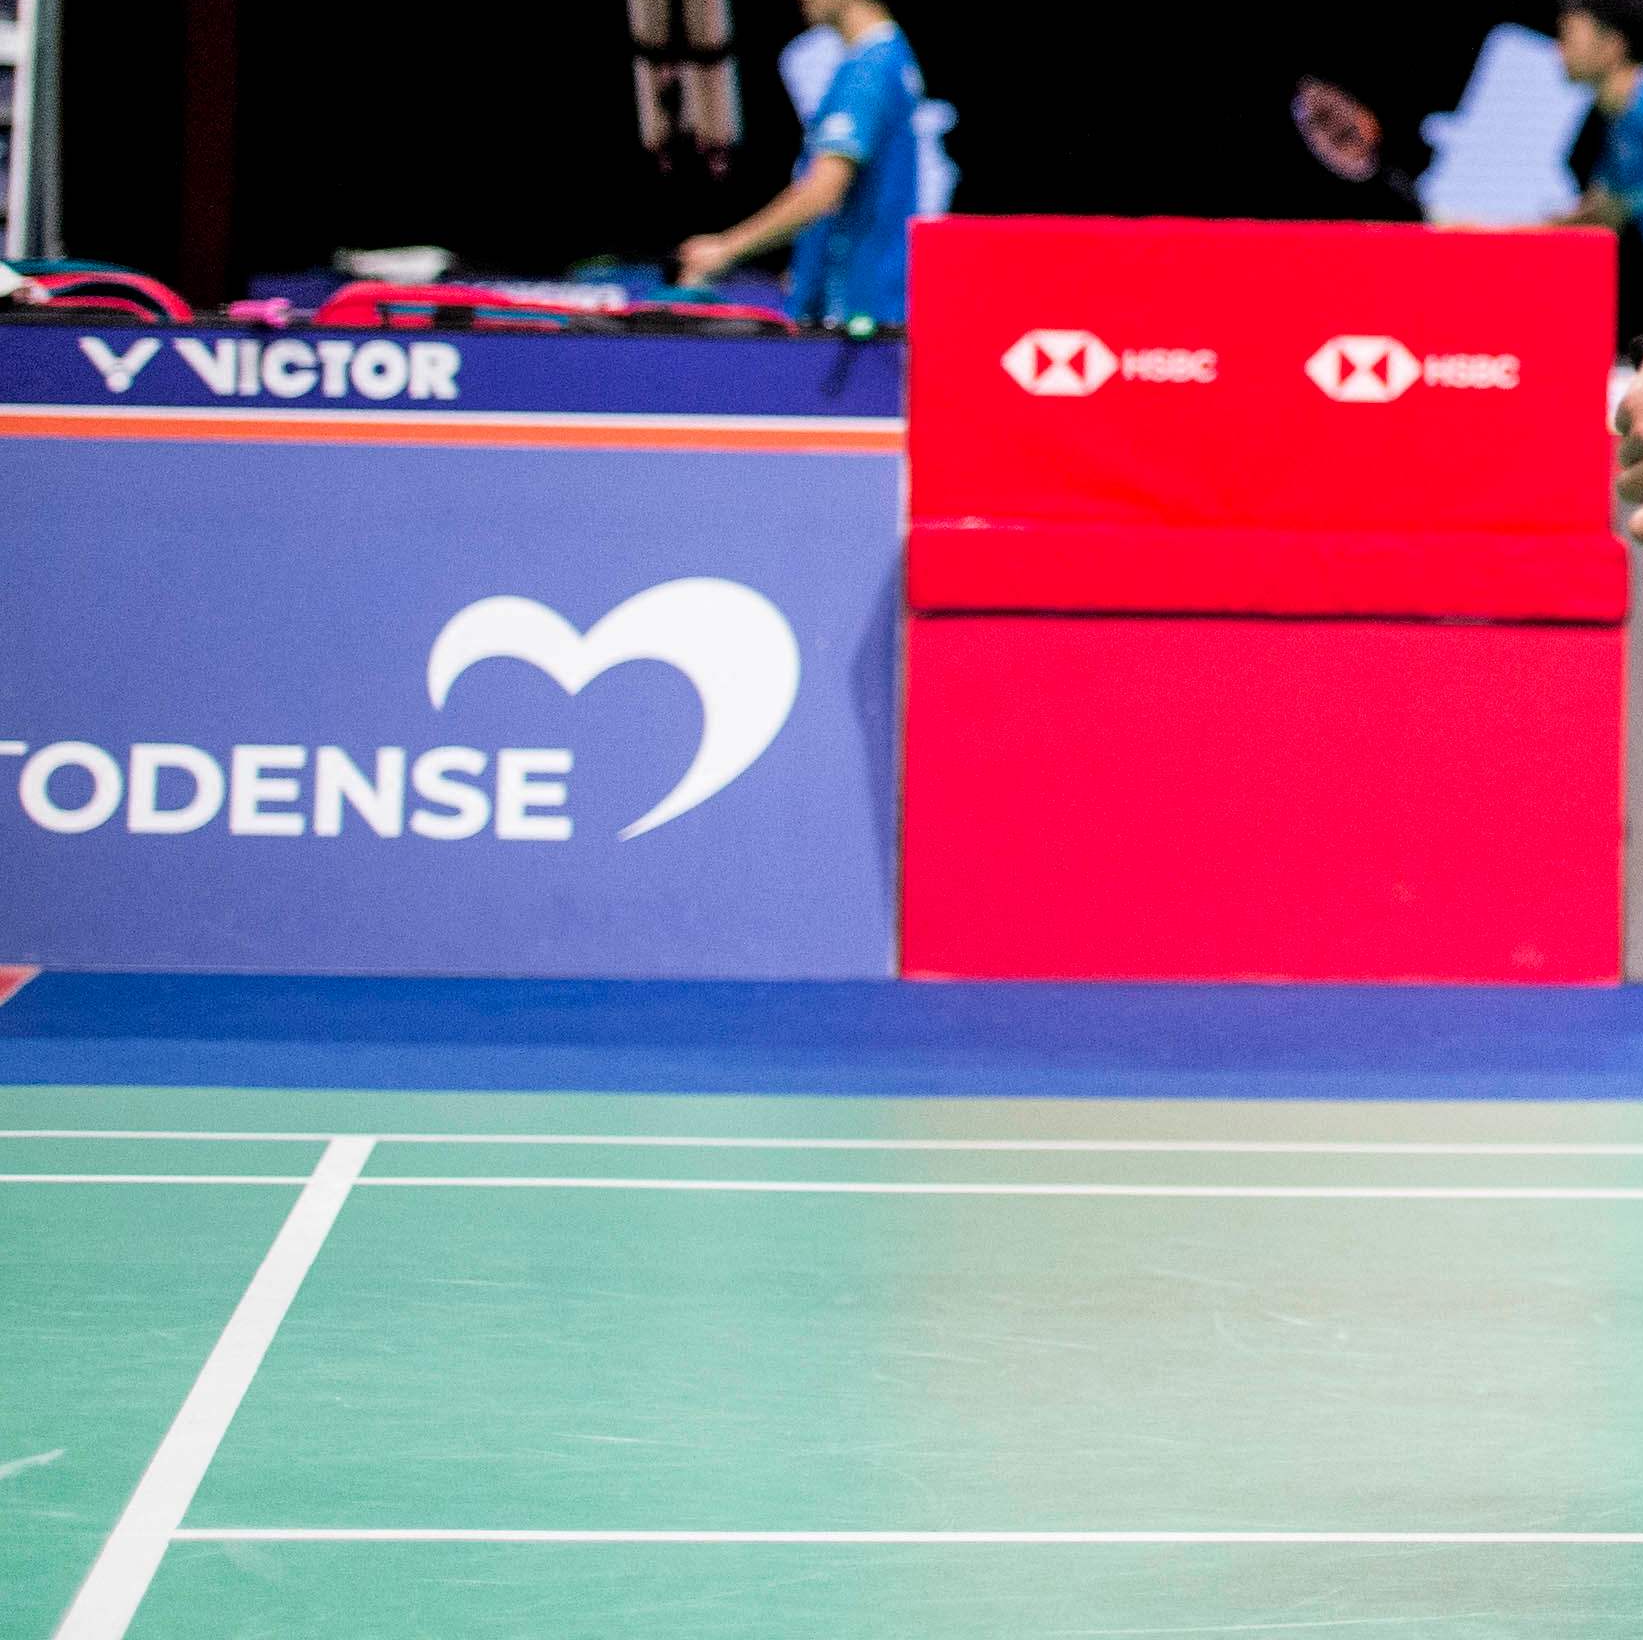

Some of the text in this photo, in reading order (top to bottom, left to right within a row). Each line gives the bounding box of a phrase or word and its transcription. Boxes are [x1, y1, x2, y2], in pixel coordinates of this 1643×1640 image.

[175, 338, 461, 400] VICTOR
[1121, 348, 1219, 384] HSBC
[1423, 354, 1521, 390] HSBC
